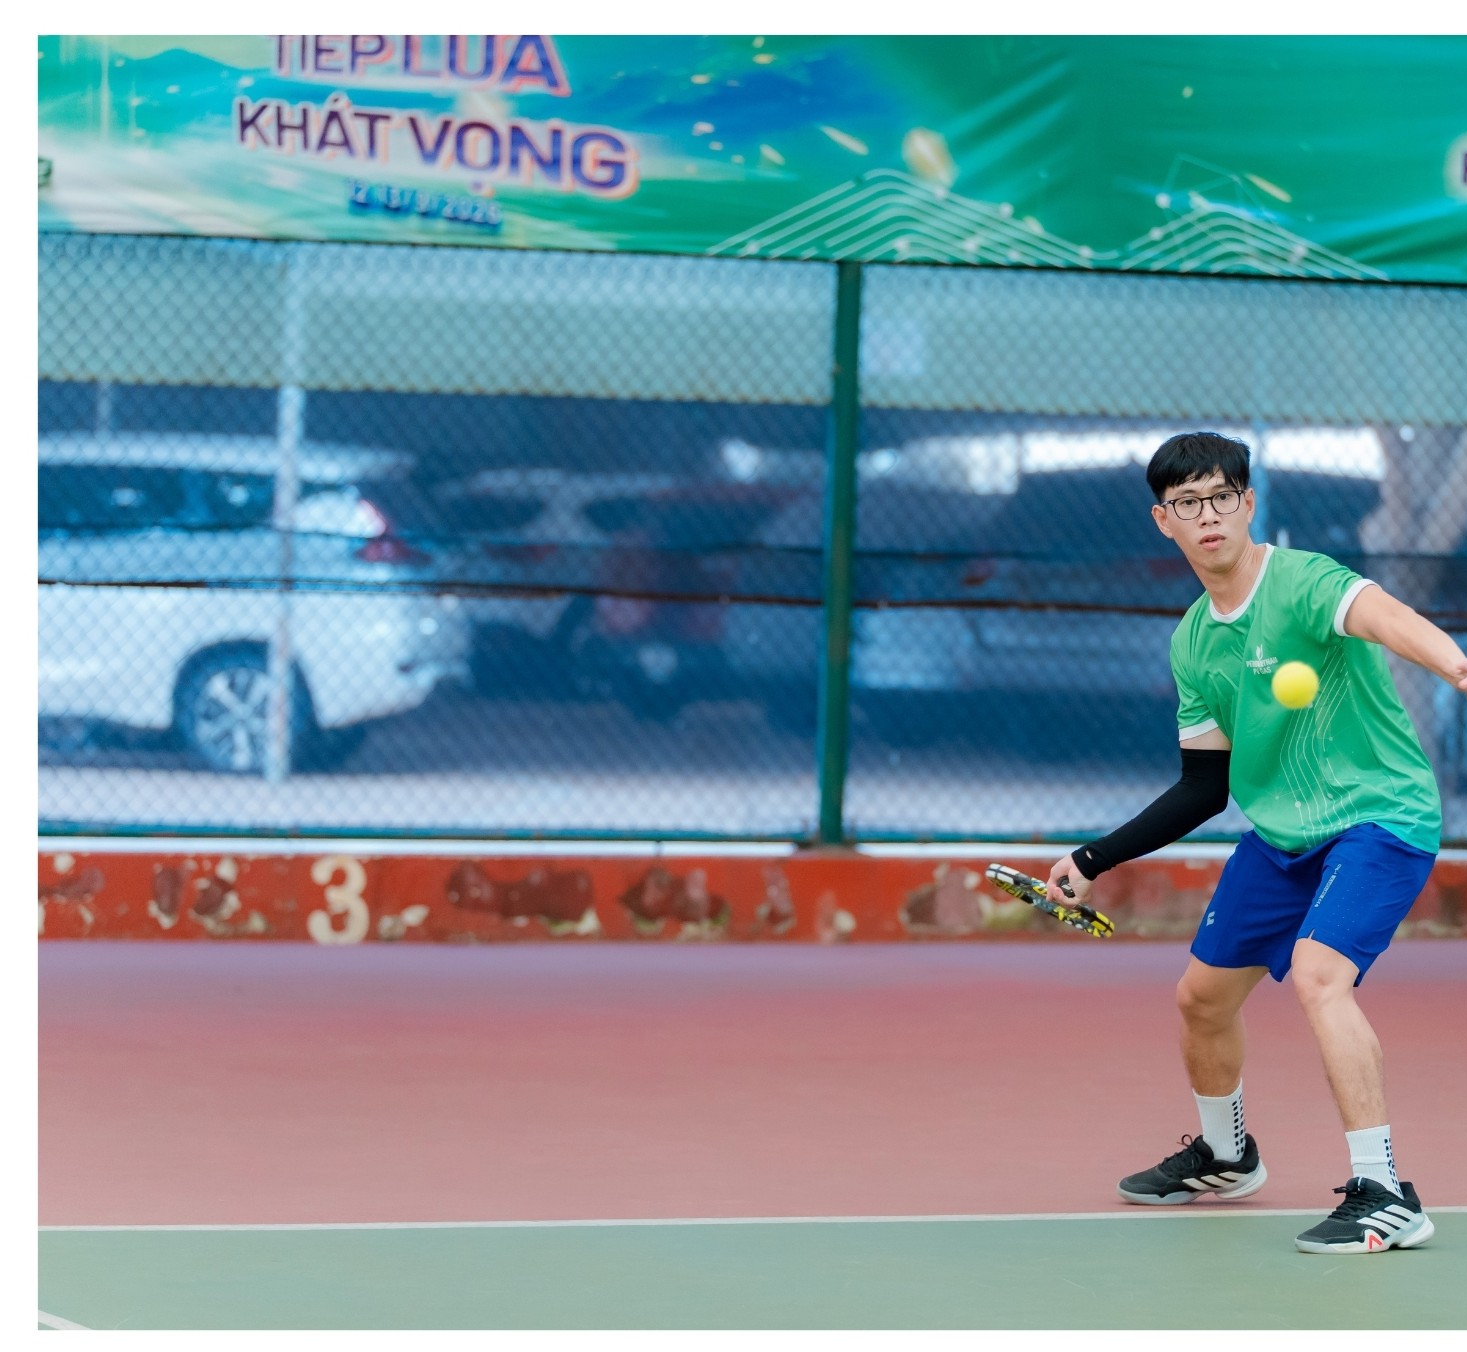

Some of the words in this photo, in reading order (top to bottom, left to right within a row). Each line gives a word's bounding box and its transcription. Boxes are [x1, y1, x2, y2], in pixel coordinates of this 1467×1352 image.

[238, 96, 391, 160] KHÁT
[408, 114, 630, 192] VỌNG
[308, 855, 370, 945] 3
